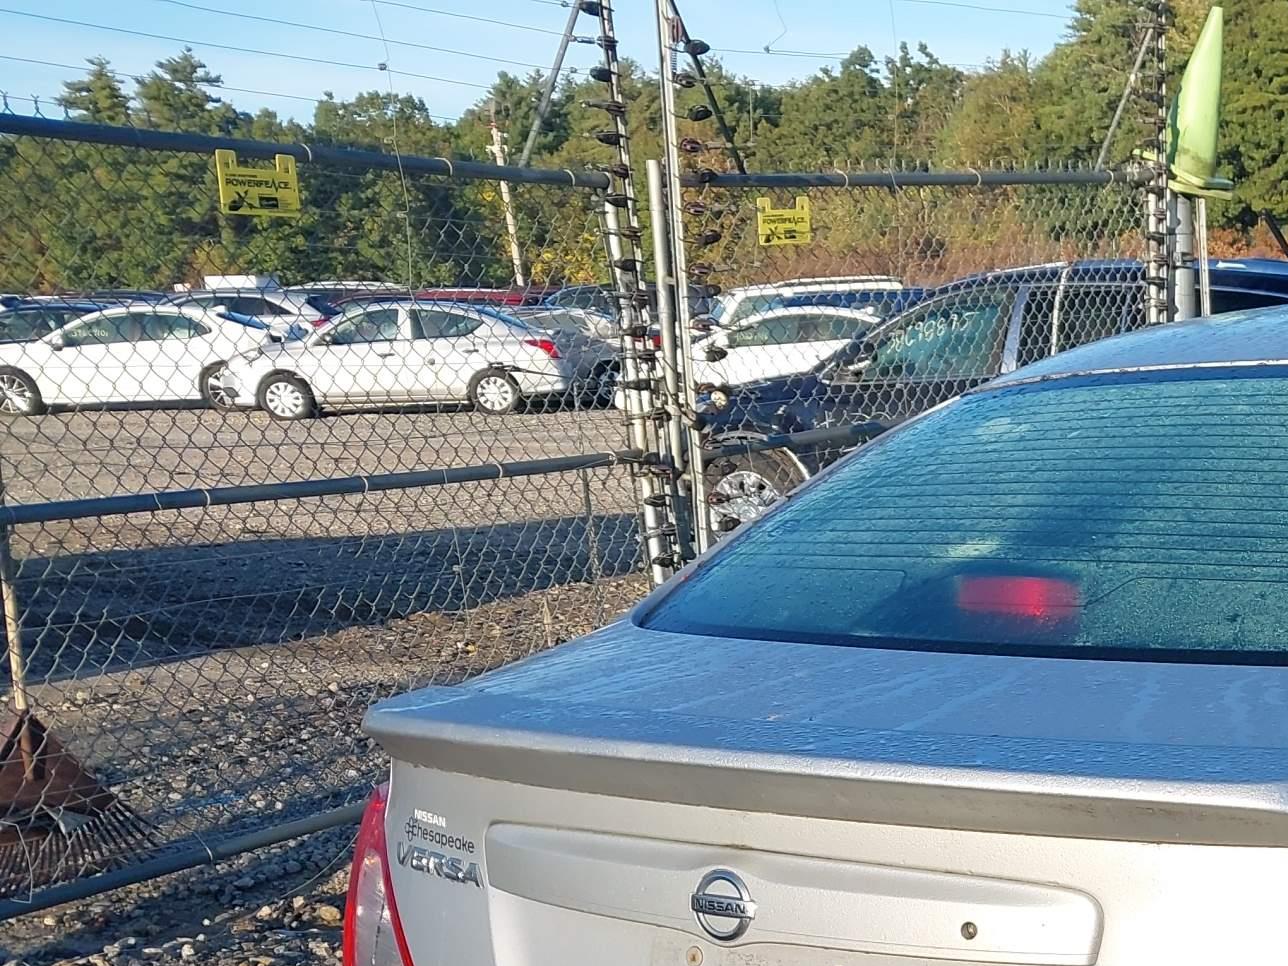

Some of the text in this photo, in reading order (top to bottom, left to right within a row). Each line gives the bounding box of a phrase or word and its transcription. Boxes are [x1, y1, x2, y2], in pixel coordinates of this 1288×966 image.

[414, 808, 446, 828] NISSAN
[397, 842, 484, 888] VERSA
[695, 898, 746, 915] NISSAN
